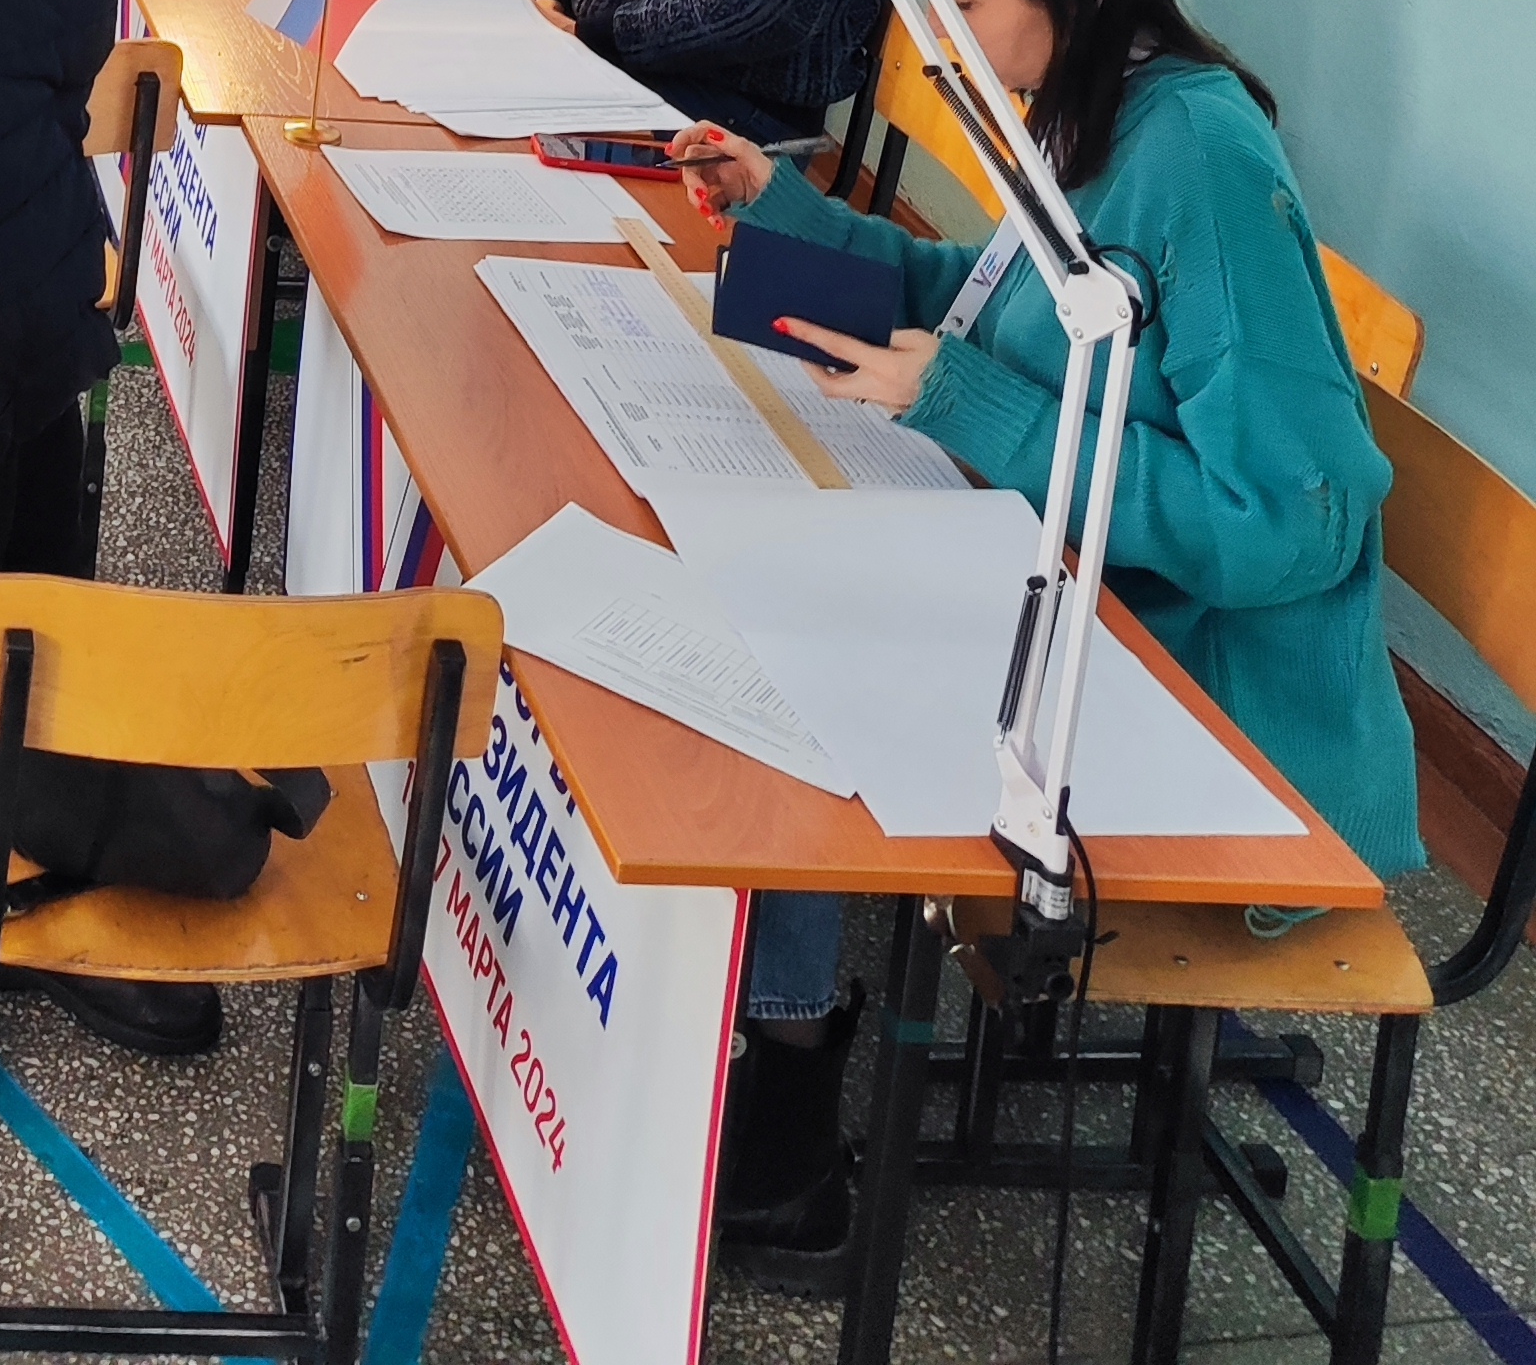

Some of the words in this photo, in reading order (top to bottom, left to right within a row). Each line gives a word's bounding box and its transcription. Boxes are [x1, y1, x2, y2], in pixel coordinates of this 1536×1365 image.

[150, 228, 177, 317] МАРТА
[174, 294, 196, 368] 2024
[447, 760, 524, 947] ССИИ
[483, 714, 620, 1031] ЗИДЕНТА
[446, 867, 514, 1050] МАРТА
[510, 1028, 567, 1174] 2024
